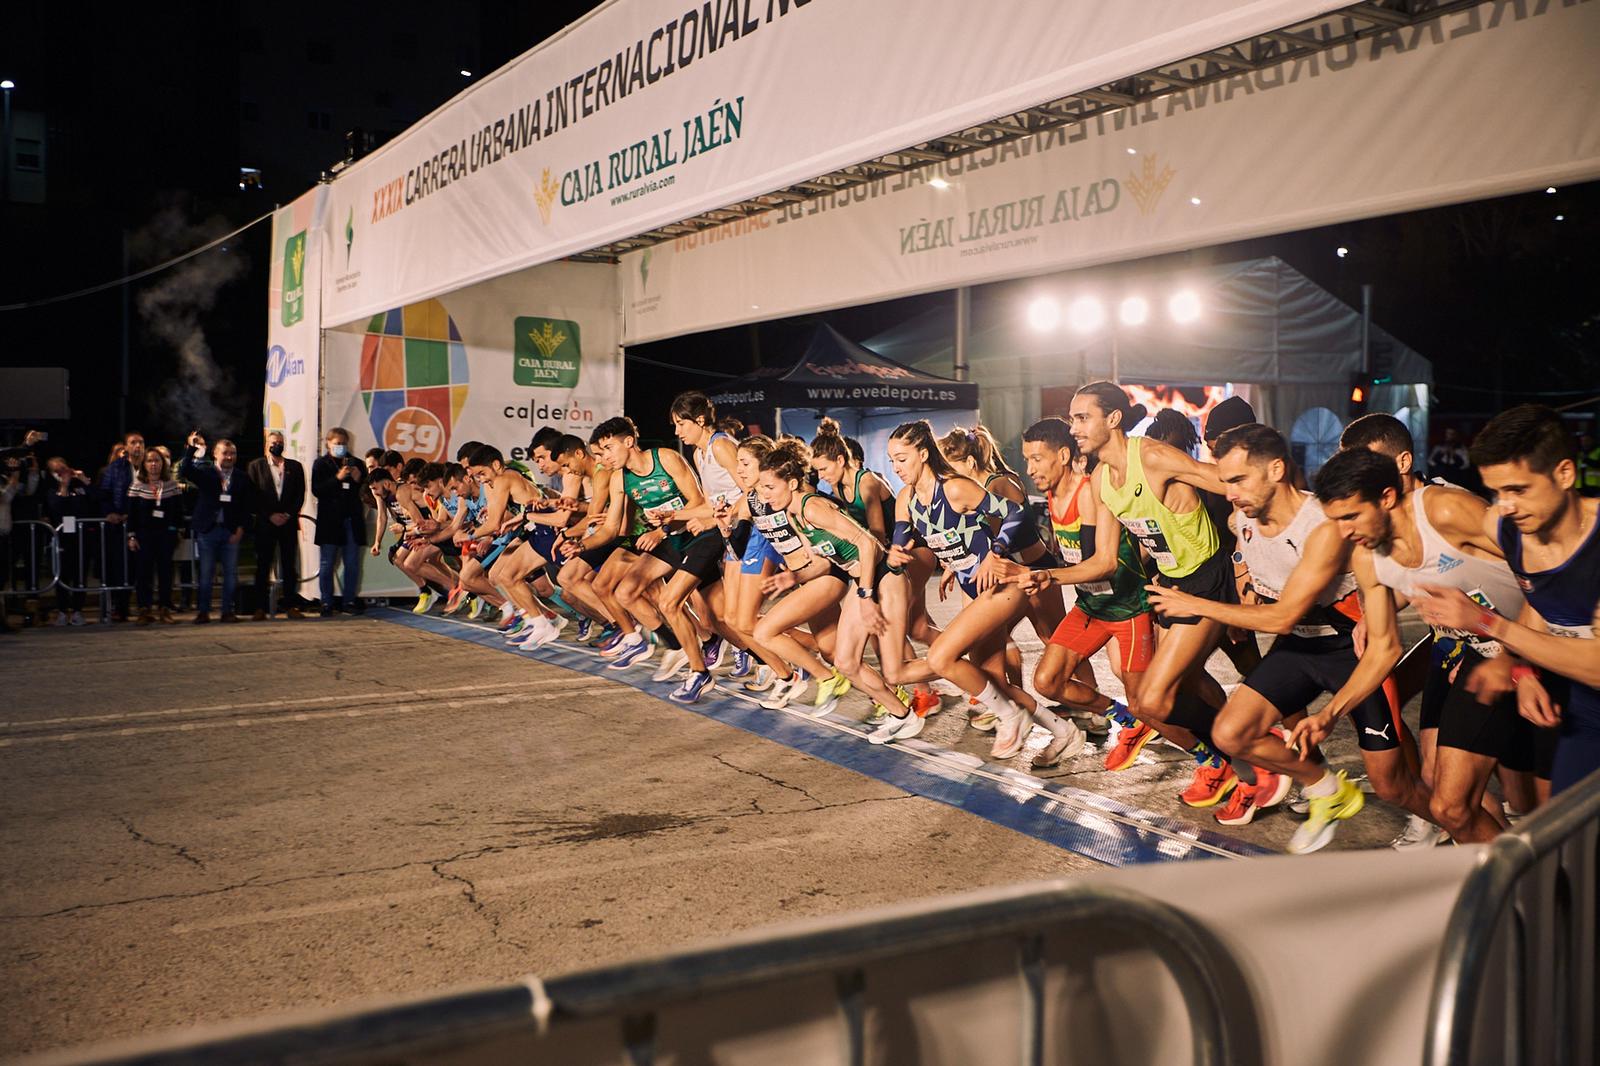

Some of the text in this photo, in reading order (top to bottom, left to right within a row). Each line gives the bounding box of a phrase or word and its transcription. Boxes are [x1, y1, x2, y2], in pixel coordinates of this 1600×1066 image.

[371, 0, 760, 225] XXXIX CARRERA URBANA INTERNACIONAL
[560, 96, 744, 207] CAJA RURAL JAÉN
[610, 174, 675, 207] www.ruralvia.com
[518, 358, 577, 370] CAJA RURAL
[807, 384, 957, 402] www.evedeport.es
[389, 422, 441, 454] 39
